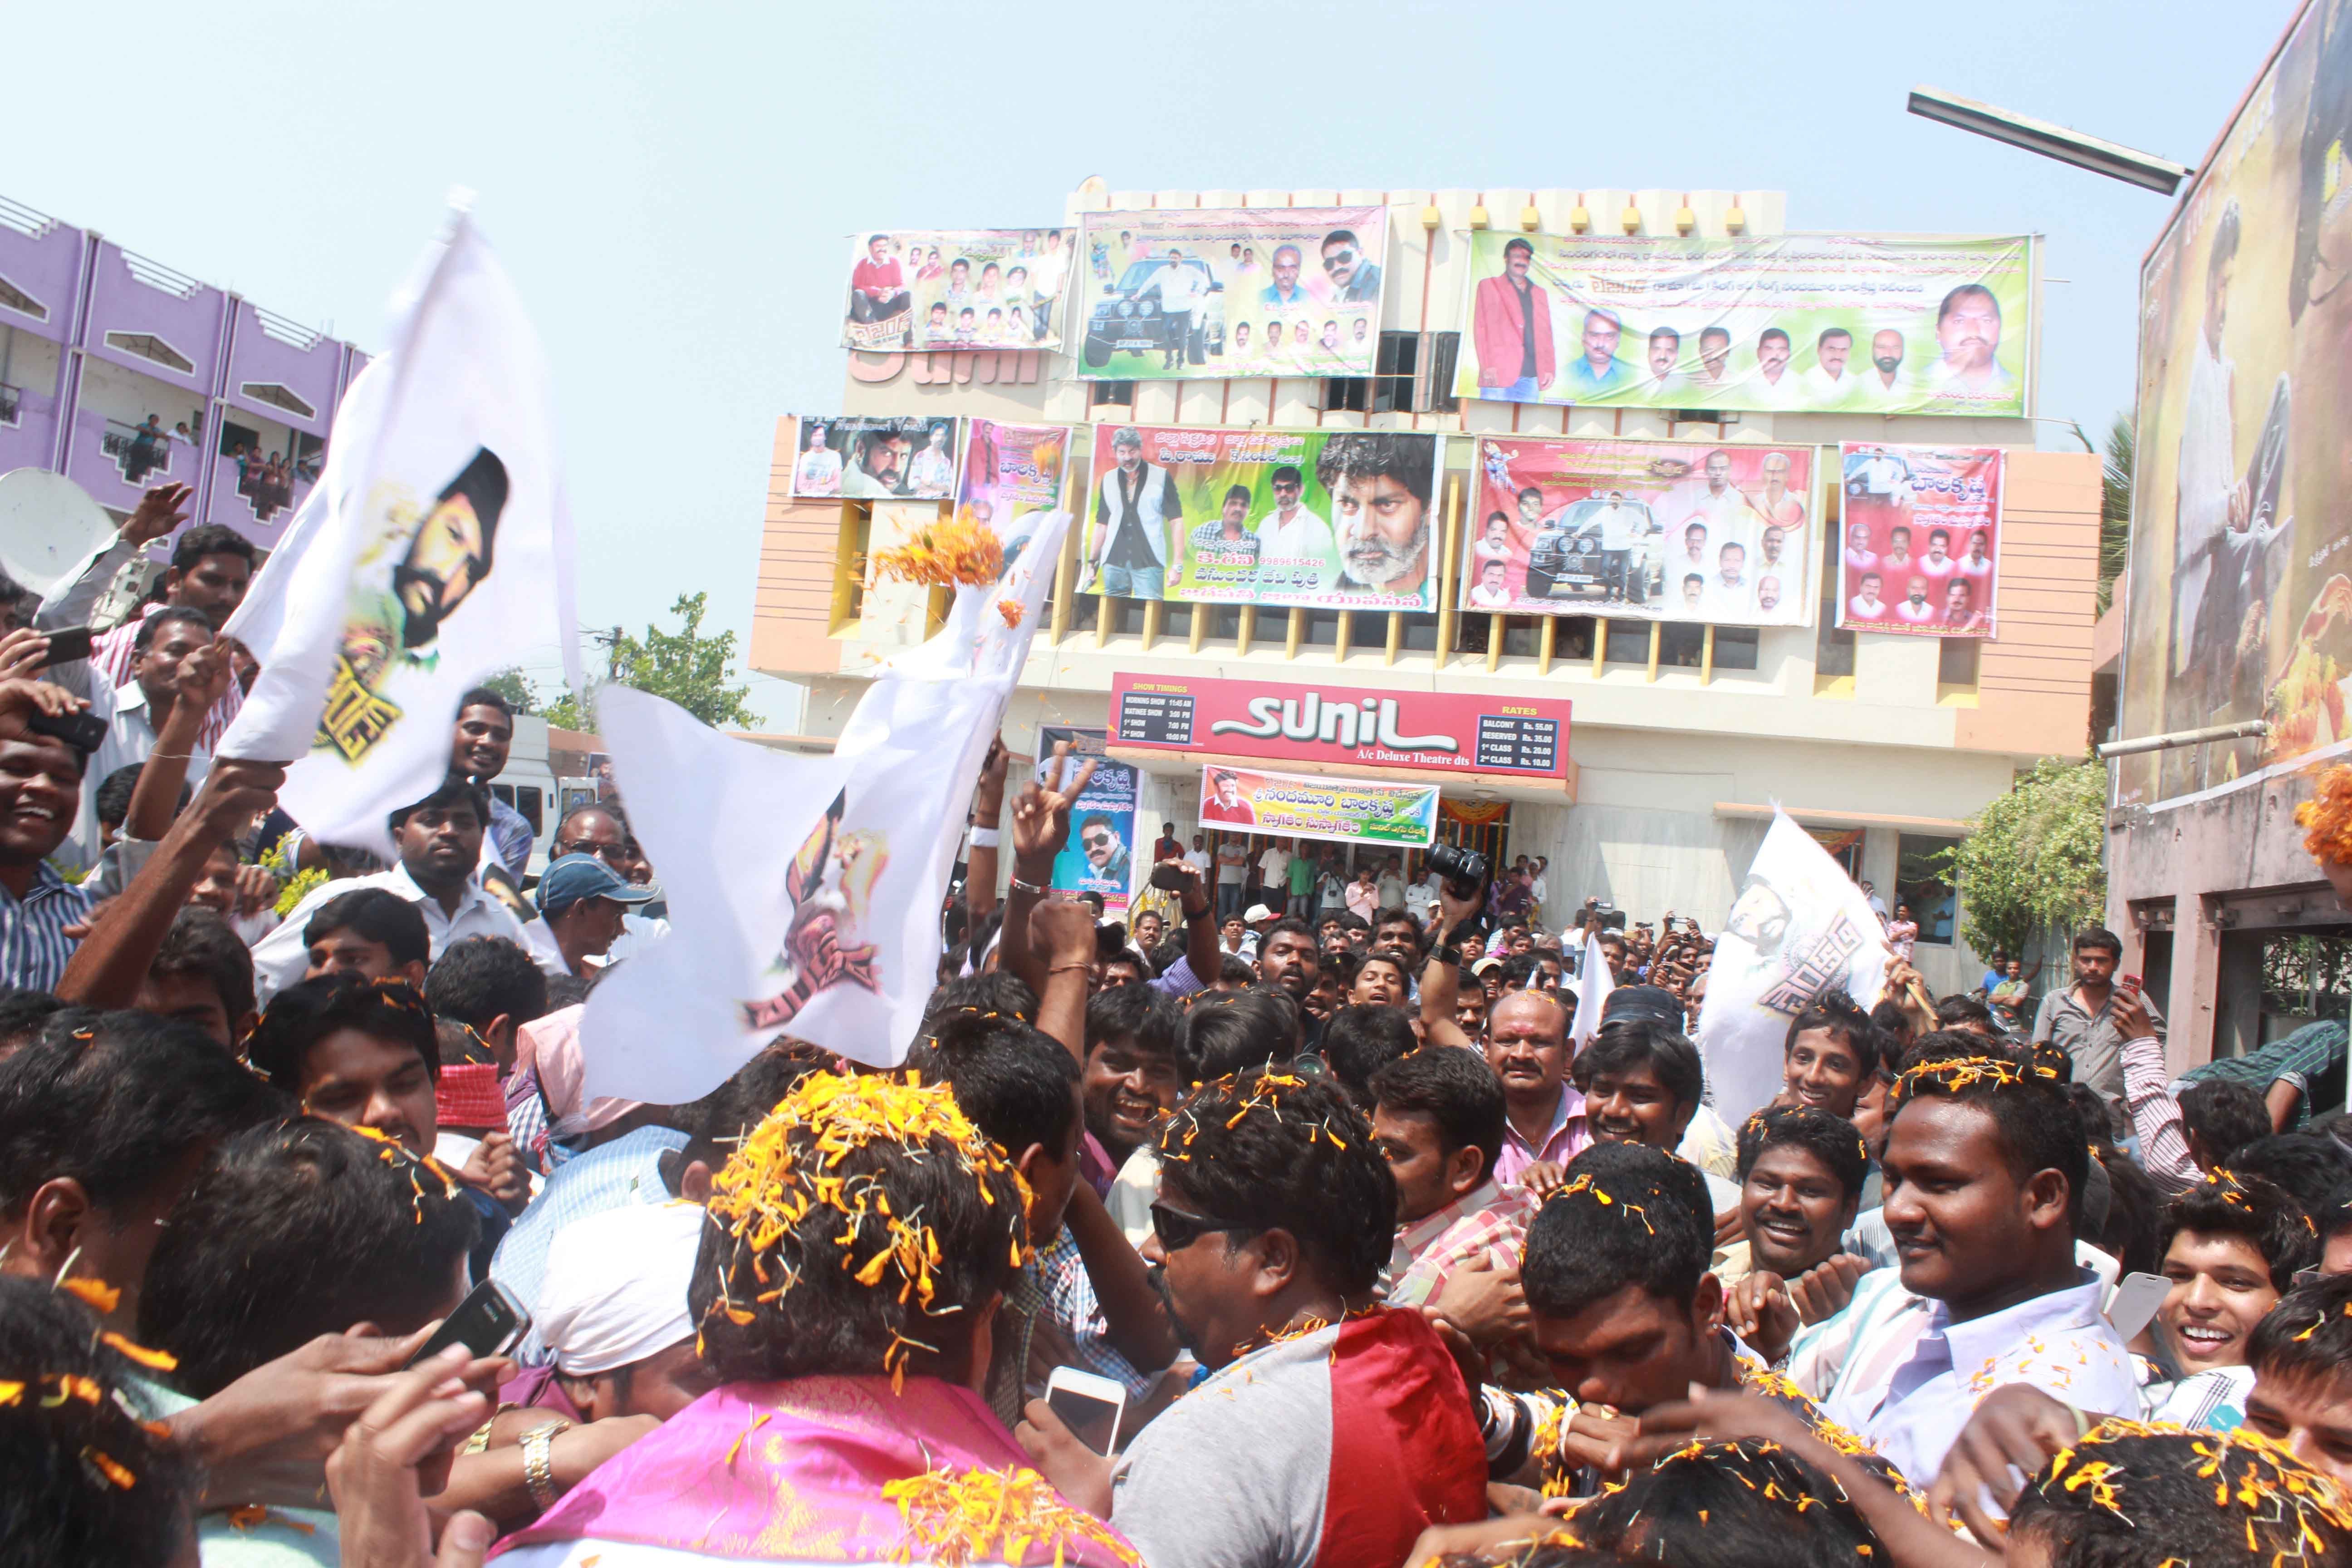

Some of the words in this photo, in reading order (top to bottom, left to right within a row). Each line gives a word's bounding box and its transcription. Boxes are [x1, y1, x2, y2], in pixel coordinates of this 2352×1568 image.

[1132, 682, 1155, 691] SHOW
[1156, 684, 1188, 693] TIMINGS
[1502, 706, 1538, 716] RATES
[1483, 719, 1515, 729] BALCONY
[1523, 722, 1534, 731] Rs.
[1534, 723, 1554, 731] 55.00
[1481, 731, 1517, 741] RESERVED
[1522, 734, 1533, 743] Rs.
[1534, 735, 1553, 744] 35.00
[1490, 744, 1512, 753] CLASS
[1520, 746, 1532, 755] Rs.
[1357, 750, 1374, 760] A/c
[1376, 750, 1411, 763] Deluxe
[1412, 752, 1452, 765] Theatre
[1454, 755, 1470, 766] dts
[1490, 755, 1512, 764] CLASS
[1520, 757, 1531, 766] Rs.
